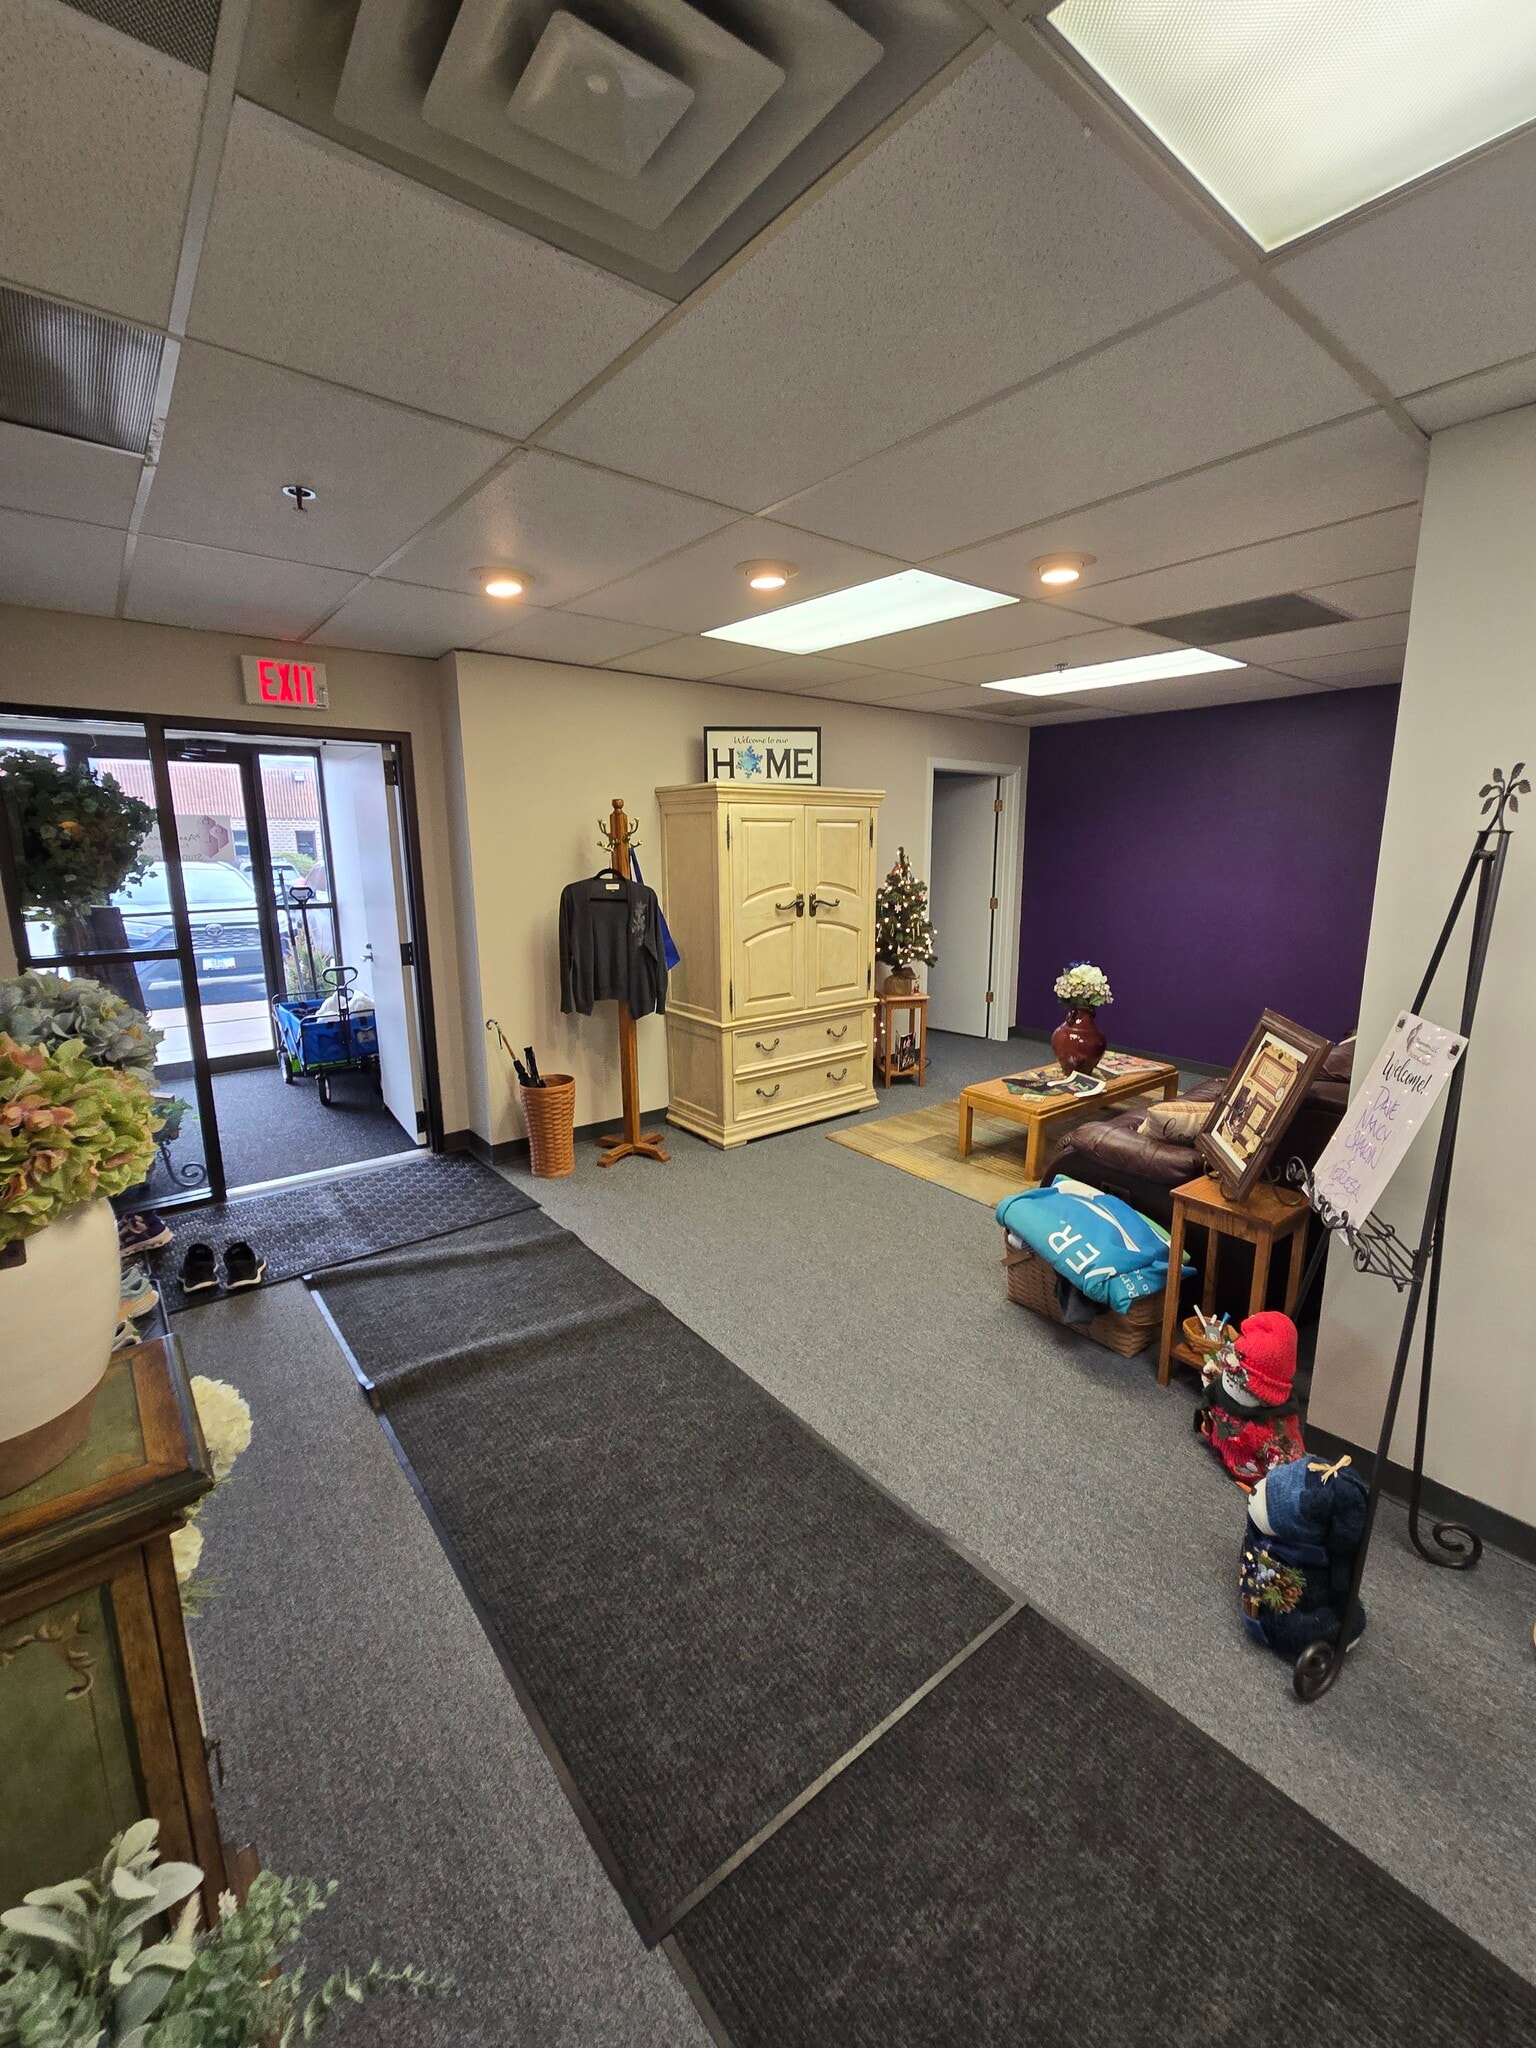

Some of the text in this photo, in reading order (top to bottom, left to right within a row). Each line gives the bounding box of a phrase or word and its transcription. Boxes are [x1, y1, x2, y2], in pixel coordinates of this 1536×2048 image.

[258, 659, 316, 705] EXIT
[733, 735, 767, 745] Welcome
[712, 747, 813, 779] HME
[1382, 1051, 1433, 1095] Welcome!
[1373, 1085, 1400, 1121] DAVE
[1355, 1109, 1393, 1146] NANCY
